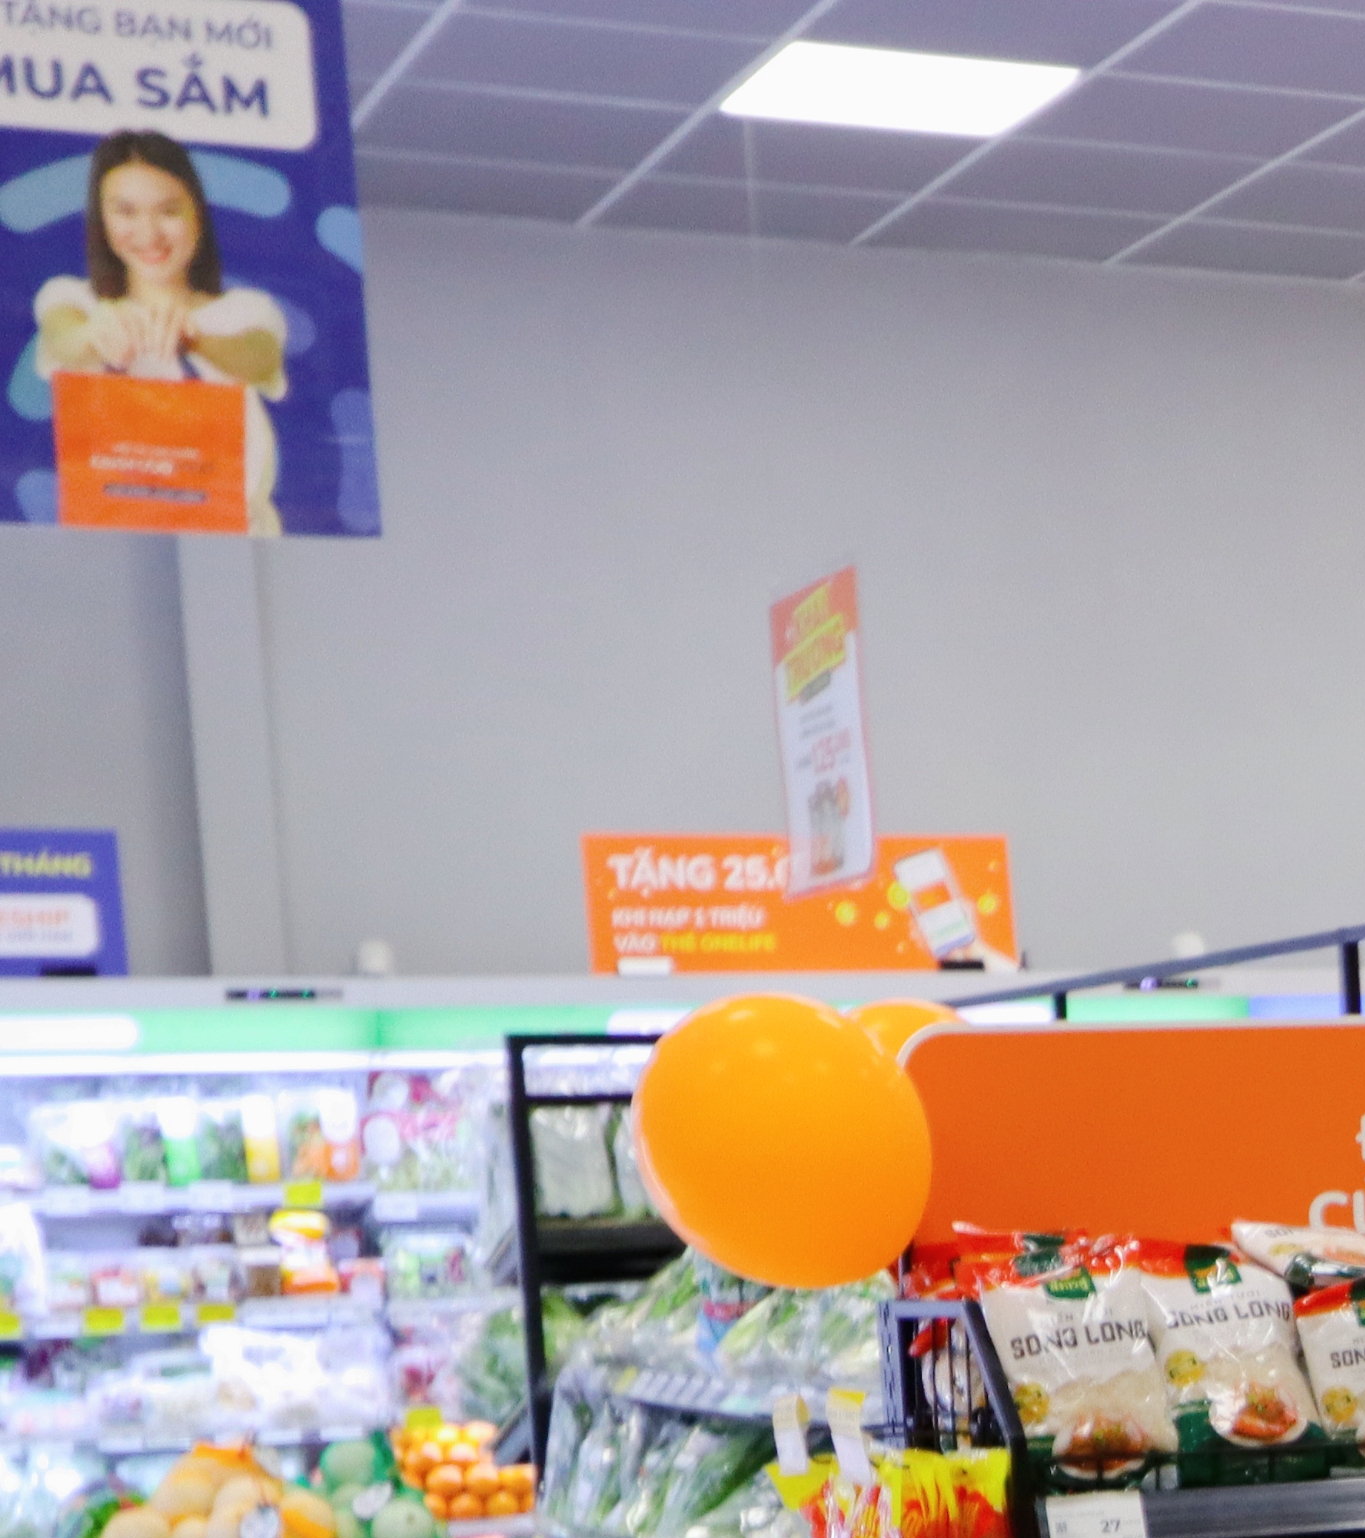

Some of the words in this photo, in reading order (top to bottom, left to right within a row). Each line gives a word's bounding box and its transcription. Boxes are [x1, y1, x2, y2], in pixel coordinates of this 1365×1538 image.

[135, 52, 268, 118] SẮM
[606, 846, 716, 898] TẶNG
[1233, 1299, 1293, 1323] LONG
[1085, 1318, 1151, 1347] LONG
[1100, 1518, 1121, 1534] 27
